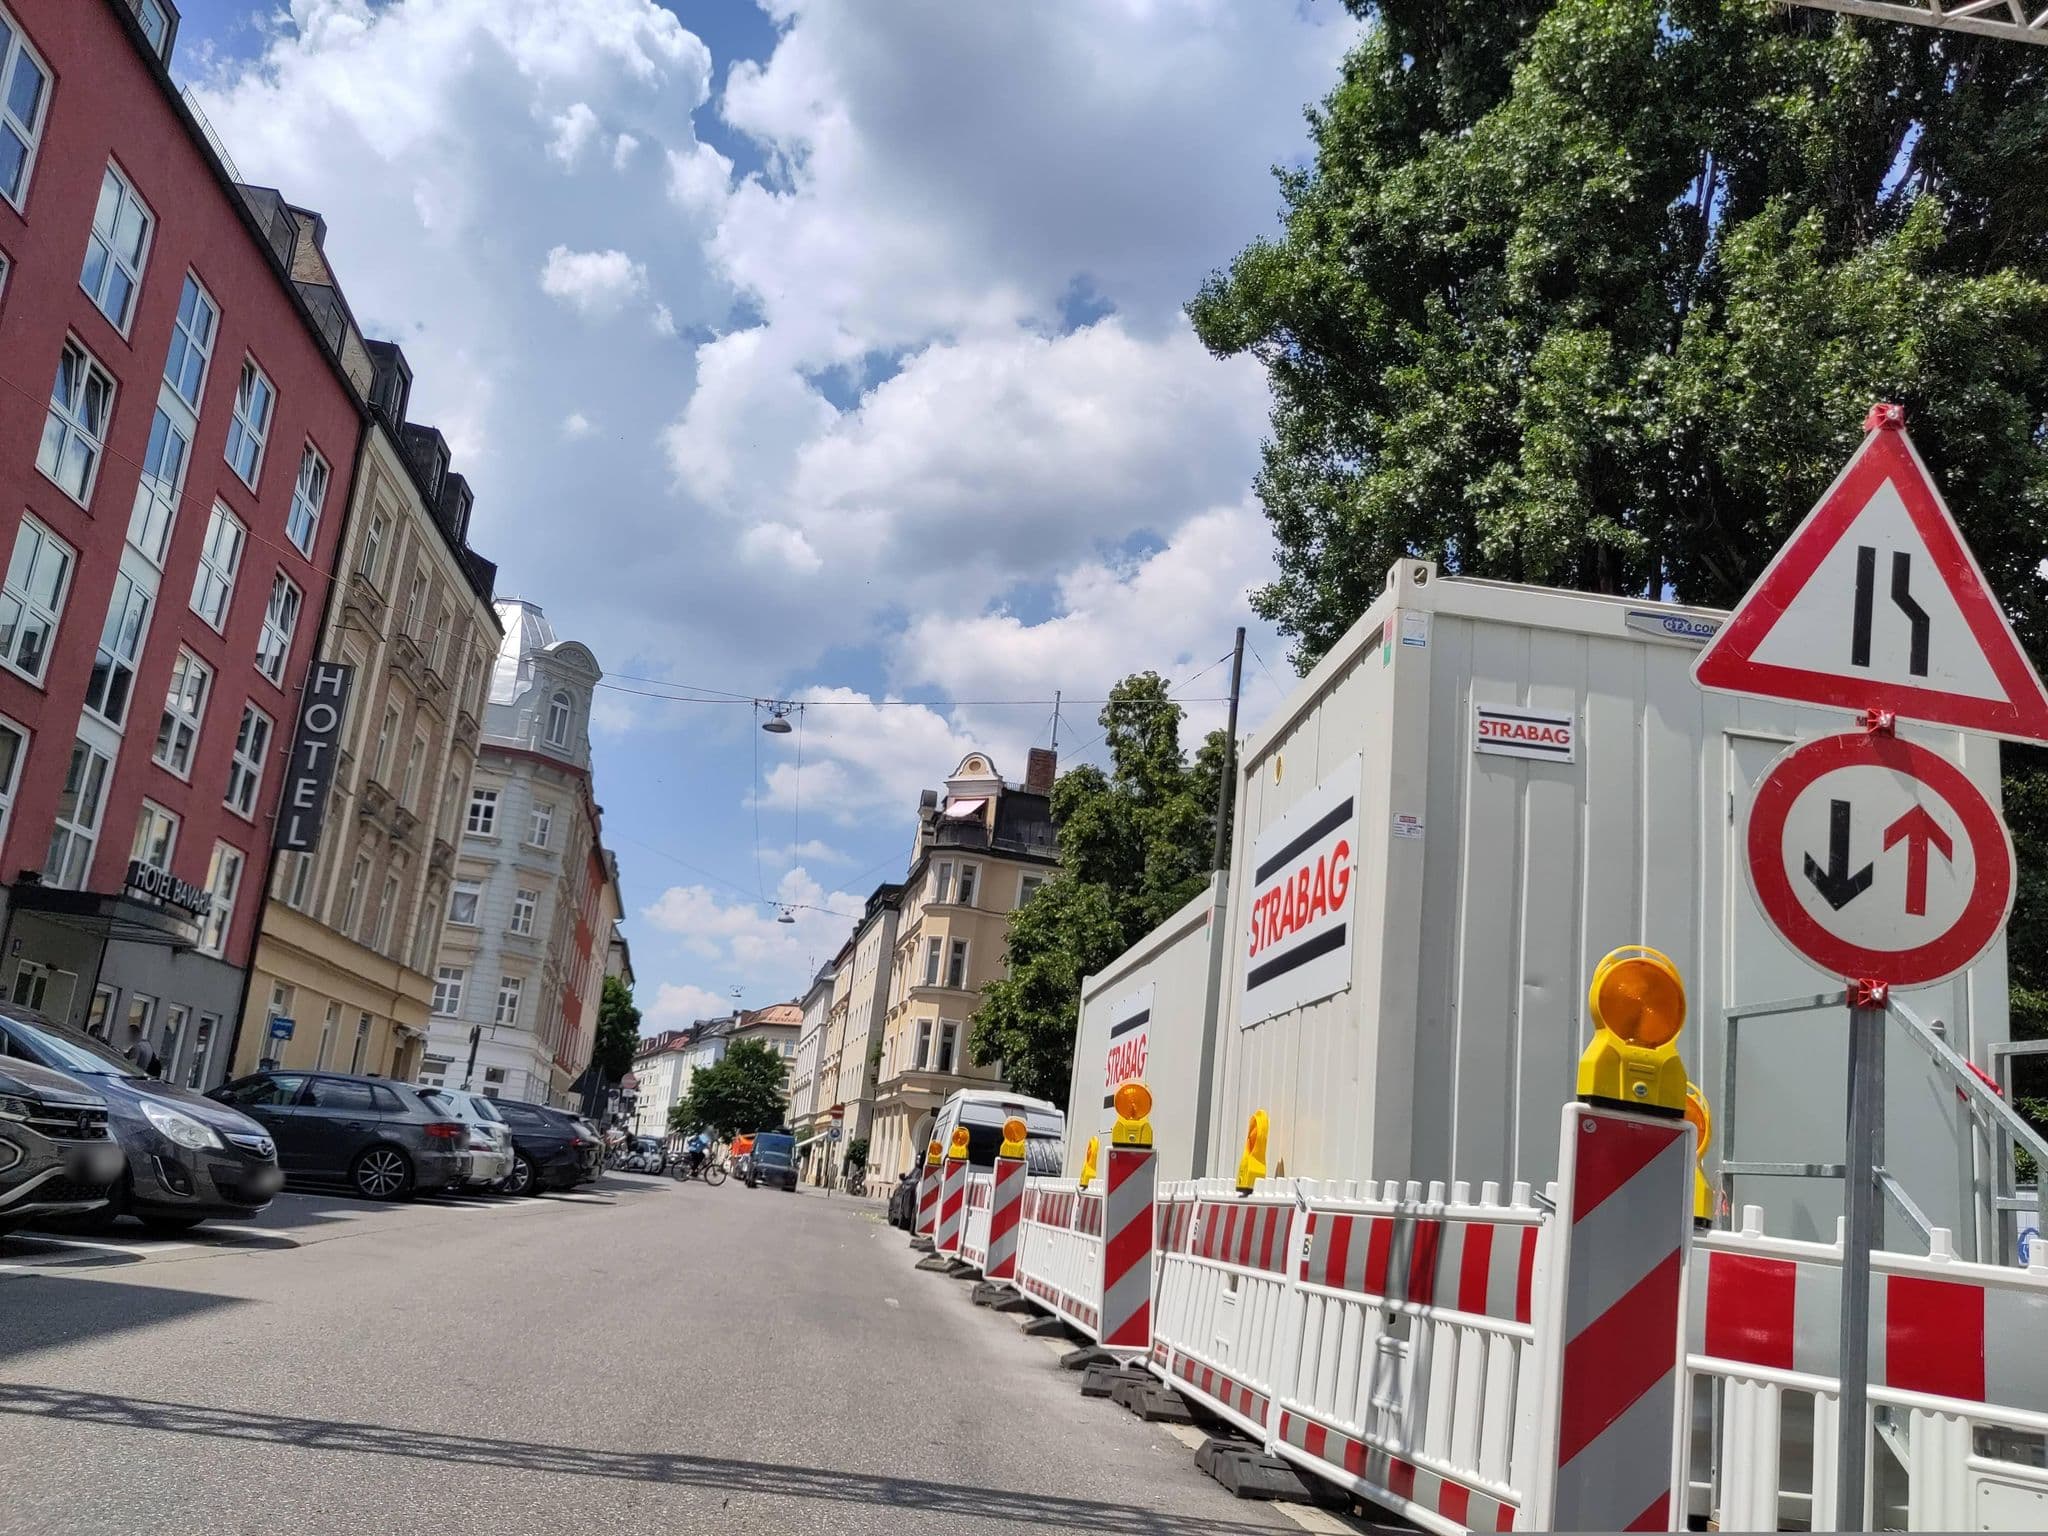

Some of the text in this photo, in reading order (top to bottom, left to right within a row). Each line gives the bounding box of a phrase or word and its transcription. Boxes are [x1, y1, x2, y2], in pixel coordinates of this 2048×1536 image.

[1694, 623, 1720, 635] CON
[1478, 720, 1570, 745] STRABAG
[288, 666, 343, 846] HOTEL
[134, 862, 170, 900] HOTEL
[1249, 839, 1350, 958] STRABAG
[1105, 1033, 1147, 1088] STRABAG
